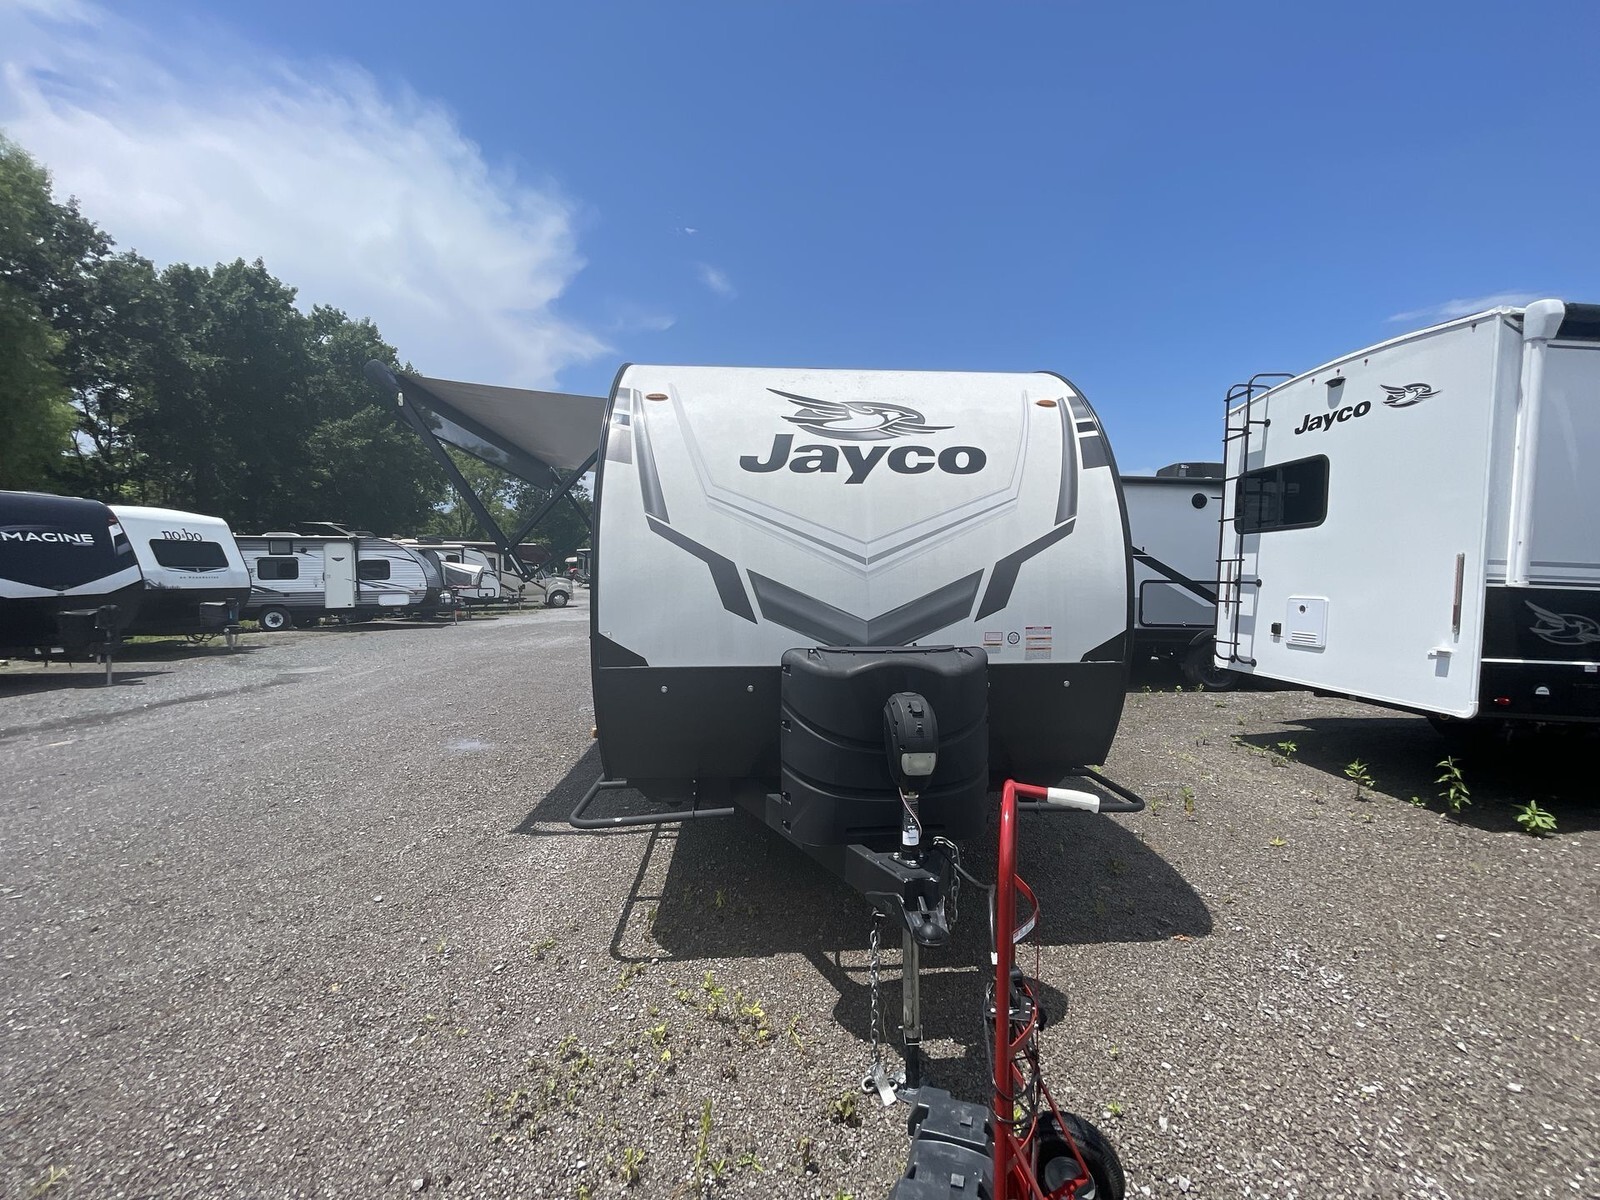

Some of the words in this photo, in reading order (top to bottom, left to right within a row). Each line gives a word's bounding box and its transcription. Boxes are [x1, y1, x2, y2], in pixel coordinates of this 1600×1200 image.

[1294, 400, 1371, 435] Jayco
[739, 433, 987, 484] Jayco
[0, 531, 95, 543] MAGINE
